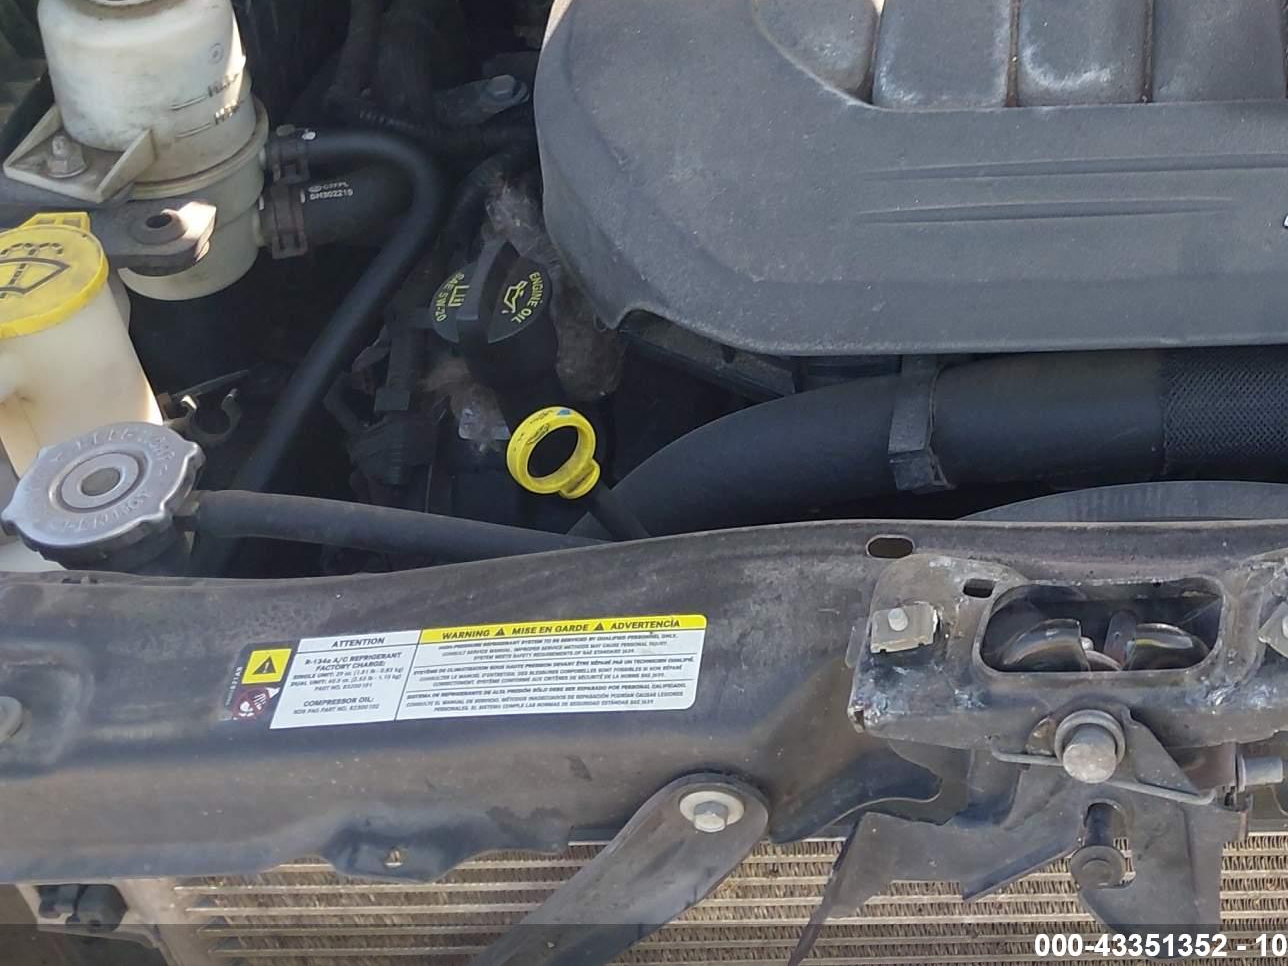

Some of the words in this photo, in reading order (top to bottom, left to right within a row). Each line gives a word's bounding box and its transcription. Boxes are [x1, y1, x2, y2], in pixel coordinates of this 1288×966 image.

[443, 272, 465, 290] SAE
[529, 272, 544, 307] ENGINE
[434, 292, 449, 322] 5W-20
[511, 308, 532, 323] OIL
[441, 629, 490, 639] WARNING
[511, 626, 537, 635] MISE
[538, 625, 553, 633] EN
[554, 623, 589, 632] GARDE
[331, 637, 385, 647] ATTENTION
[349, 652, 402, 661] REFRIGERANT
[314, 663, 351, 671] FACTORY
[302, 697, 357, 706] COMPRESSOR
